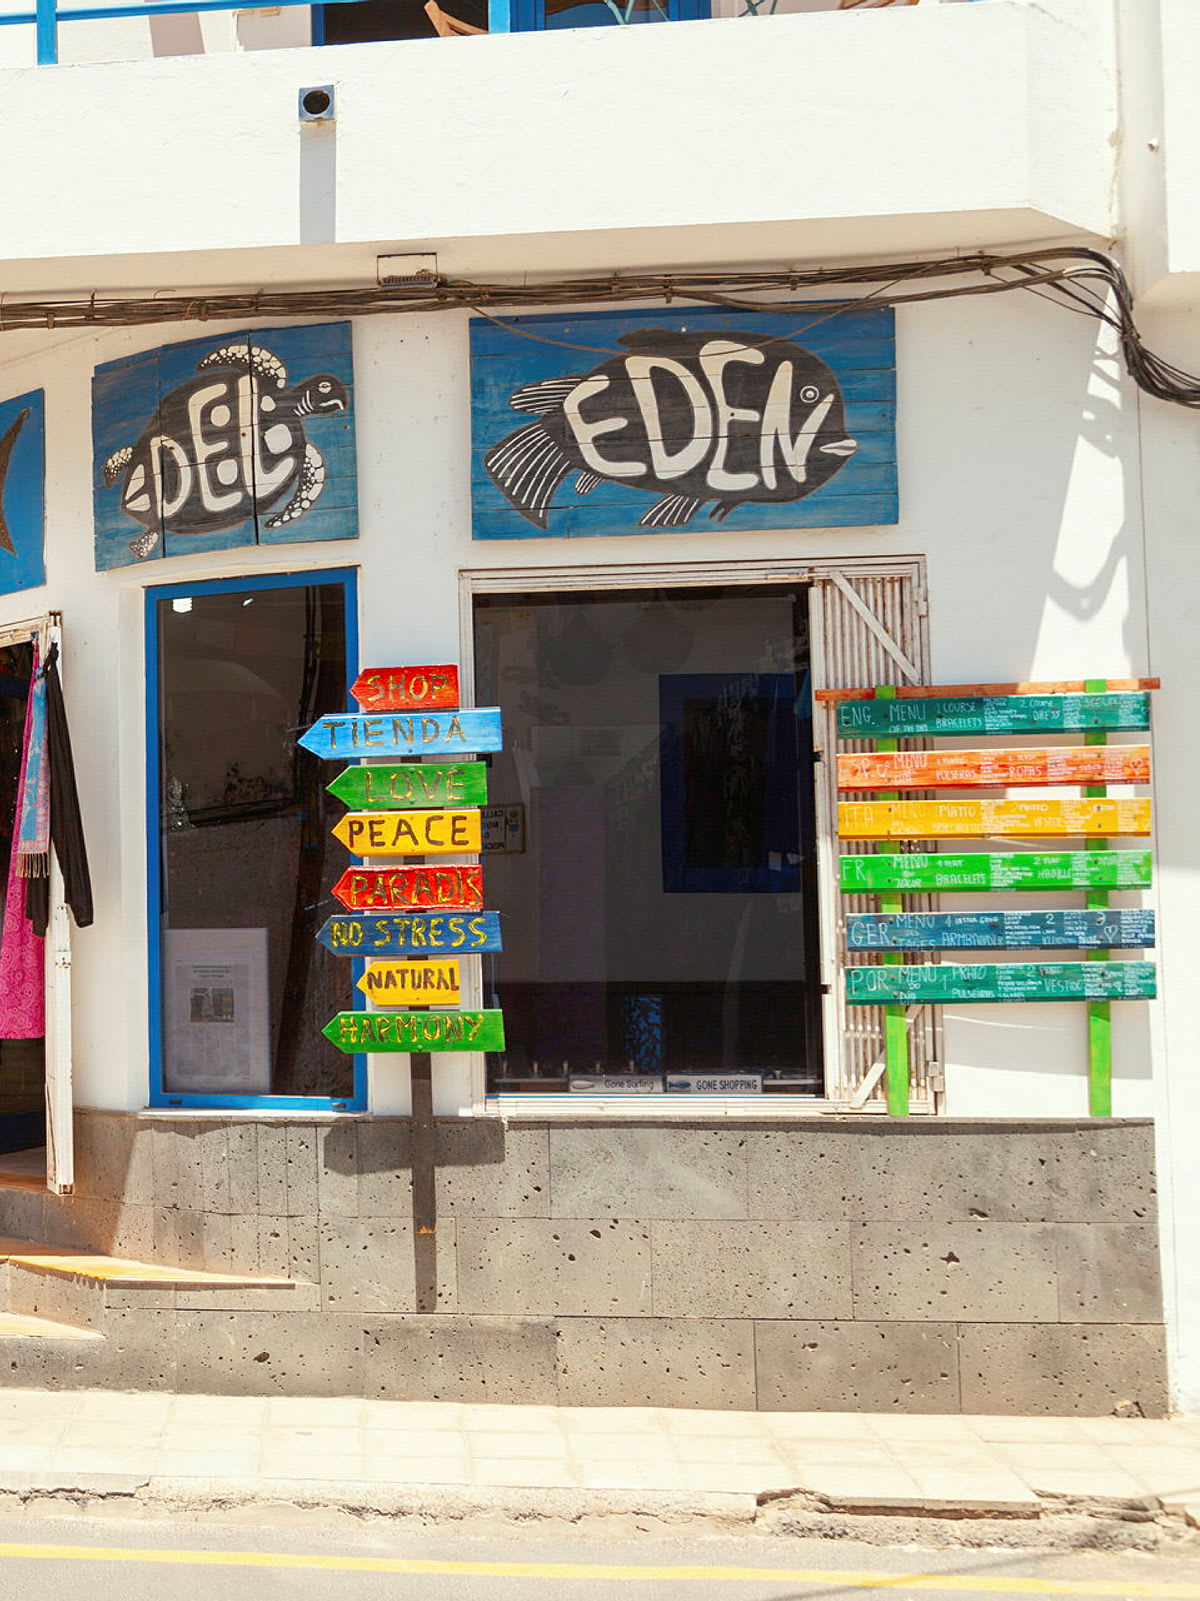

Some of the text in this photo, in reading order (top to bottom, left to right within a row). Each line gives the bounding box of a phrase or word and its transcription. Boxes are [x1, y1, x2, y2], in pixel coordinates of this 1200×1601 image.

[563, 340, 834, 492] EDEN
[149, 374, 297, 518] DEL
[367, 674, 448, 702] SHOP
[888, 703, 927, 722] MENU
[943, 701, 977, 714] COURSE
[323, 716, 467, 749] TIENDA
[935, 716, 983, 729] BRACELETS
[893, 753, 928, 769] MENU
[365, 770, 465, 803] LOVE
[348, 815, 470, 848] PEACE
[892, 855, 929, 869] MENU
[351, 871, 484, 906] PARADIS
[935, 872, 987, 886] BRACELETS
[896, 913, 936, 929] MENU
[1045, 913, 1056, 925] 2
[330, 917, 488, 947] NO STRESS
[367, 967, 460, 991] NATURAL
[850, 969, 889, 996] POR
[897, 965, 937, 984] MENU
[339, 1014, 484, 1044] HARMONY
[696, 1079, 757, 1090] GONE SHOPPING
